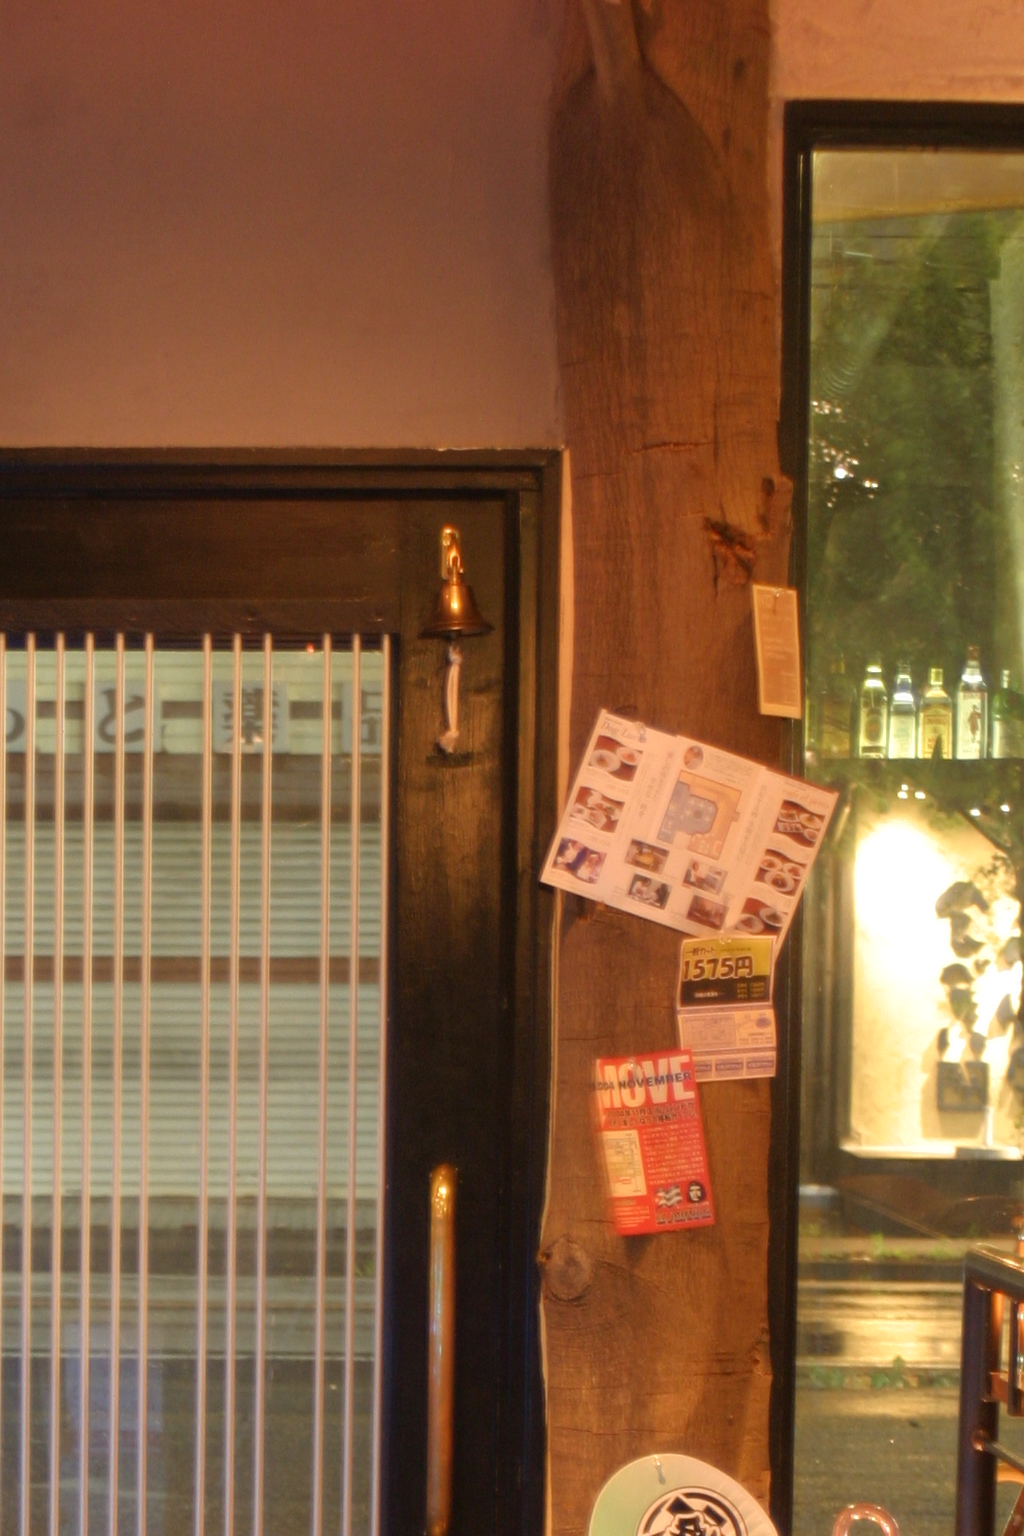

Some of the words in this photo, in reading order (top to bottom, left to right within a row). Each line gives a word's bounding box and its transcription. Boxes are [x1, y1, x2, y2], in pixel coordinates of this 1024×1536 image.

[683, 954, 754, 982] 1575円
[598, 1055, 695, 1108] MOVE
[620, 1072, 691, 1089] NOVEMBER
